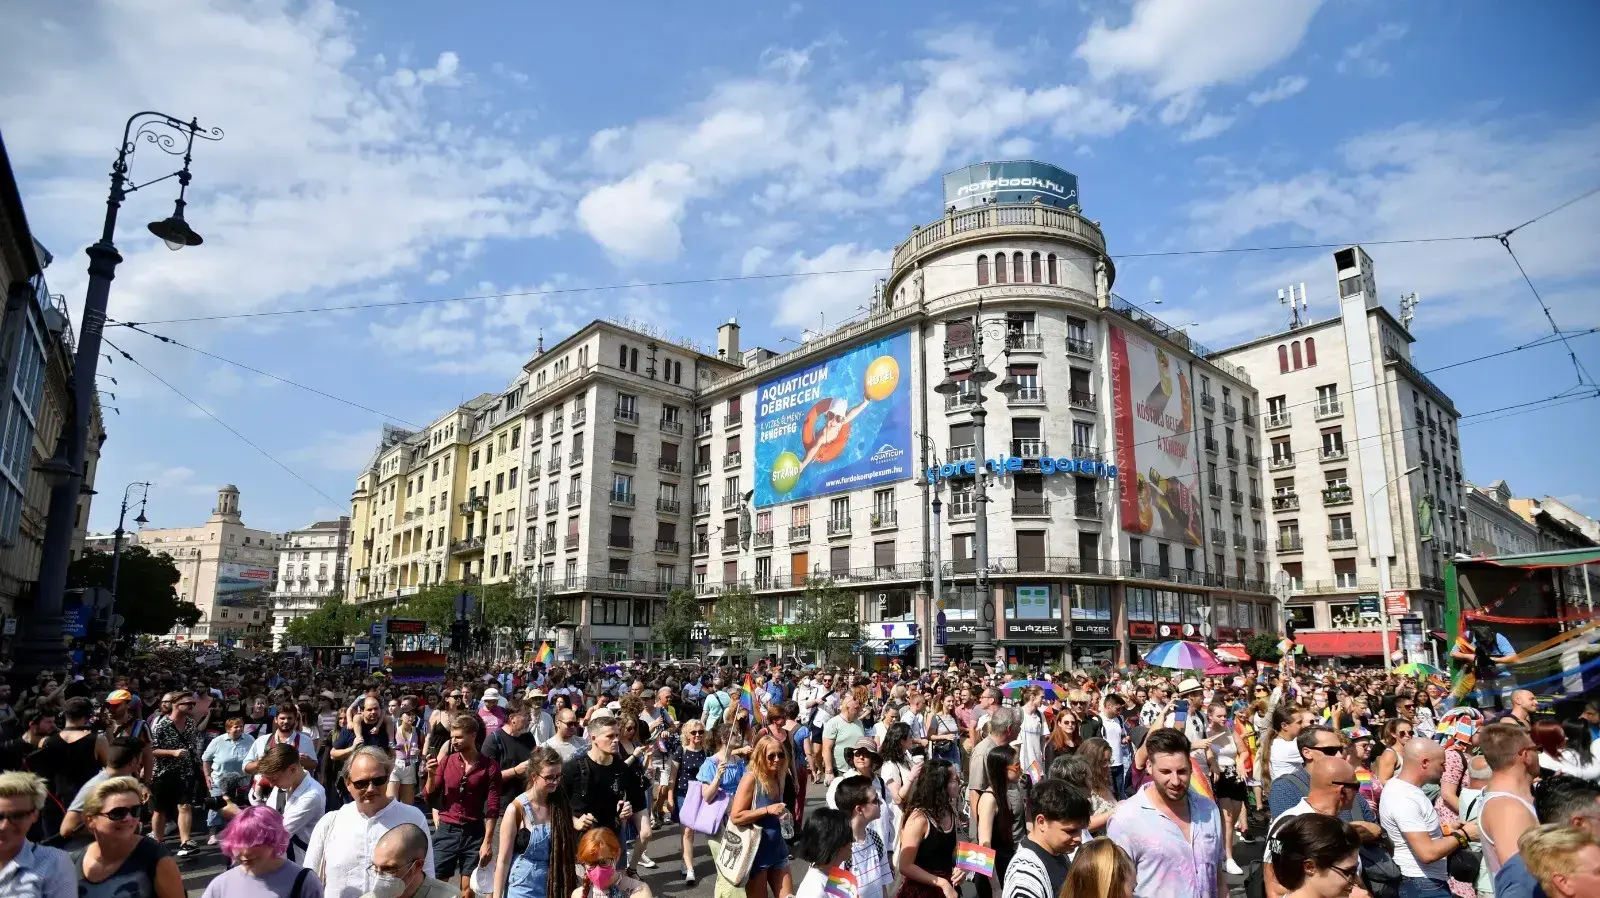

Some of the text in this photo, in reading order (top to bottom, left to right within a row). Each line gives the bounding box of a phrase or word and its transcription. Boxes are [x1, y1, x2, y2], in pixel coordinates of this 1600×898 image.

[957, 177, 1064, 196] notebook.hu
[761, 366, 829, 402] AQUATICUM
[867, 370, 894, 387] HOTEL
[760, 385, 821, 417] DEBRECEN
[760, 422, 797, 443] RENGETEG
[1110, 351, 1131, 507] JOHNNIE WALKER
[870, 449, 904, 462] AQUATICUM
[772, 467, 799, 482] STRAND
[825, 466, 903, 487] www.furdokomplexum.hu
[926, 454, 1119, 485] gorenje gorenje
[946, 625, 976, 633] BLÁZ
[1009, 624, 1058, 632] BLÁZEK
[1075, 625, 1110, 633] BLÁZEK
[965, 850, 987, 867] 25
